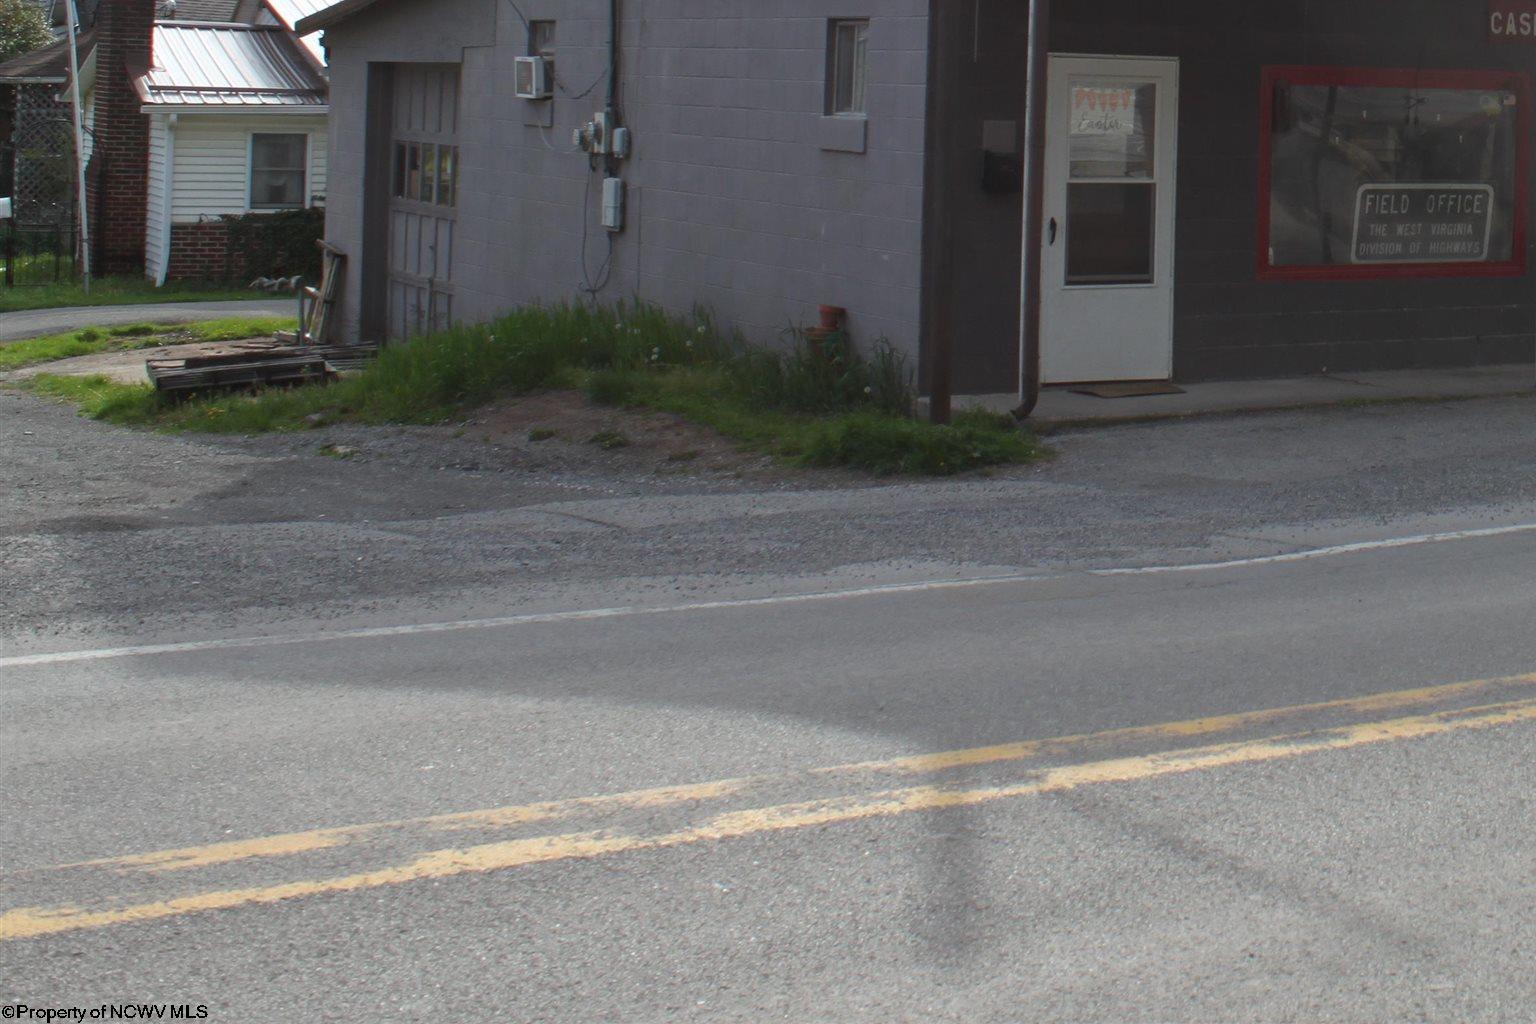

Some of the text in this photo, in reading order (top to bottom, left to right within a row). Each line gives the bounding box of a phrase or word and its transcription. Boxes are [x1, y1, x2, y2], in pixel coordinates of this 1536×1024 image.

[1365, 194, 1483, 214] FIELD OFFICE
[1369, 223, 1473, 236] THE WEST VIRGINIA
[1359, 241, 1481, 256] DIVISION OF HIGHWAYS
